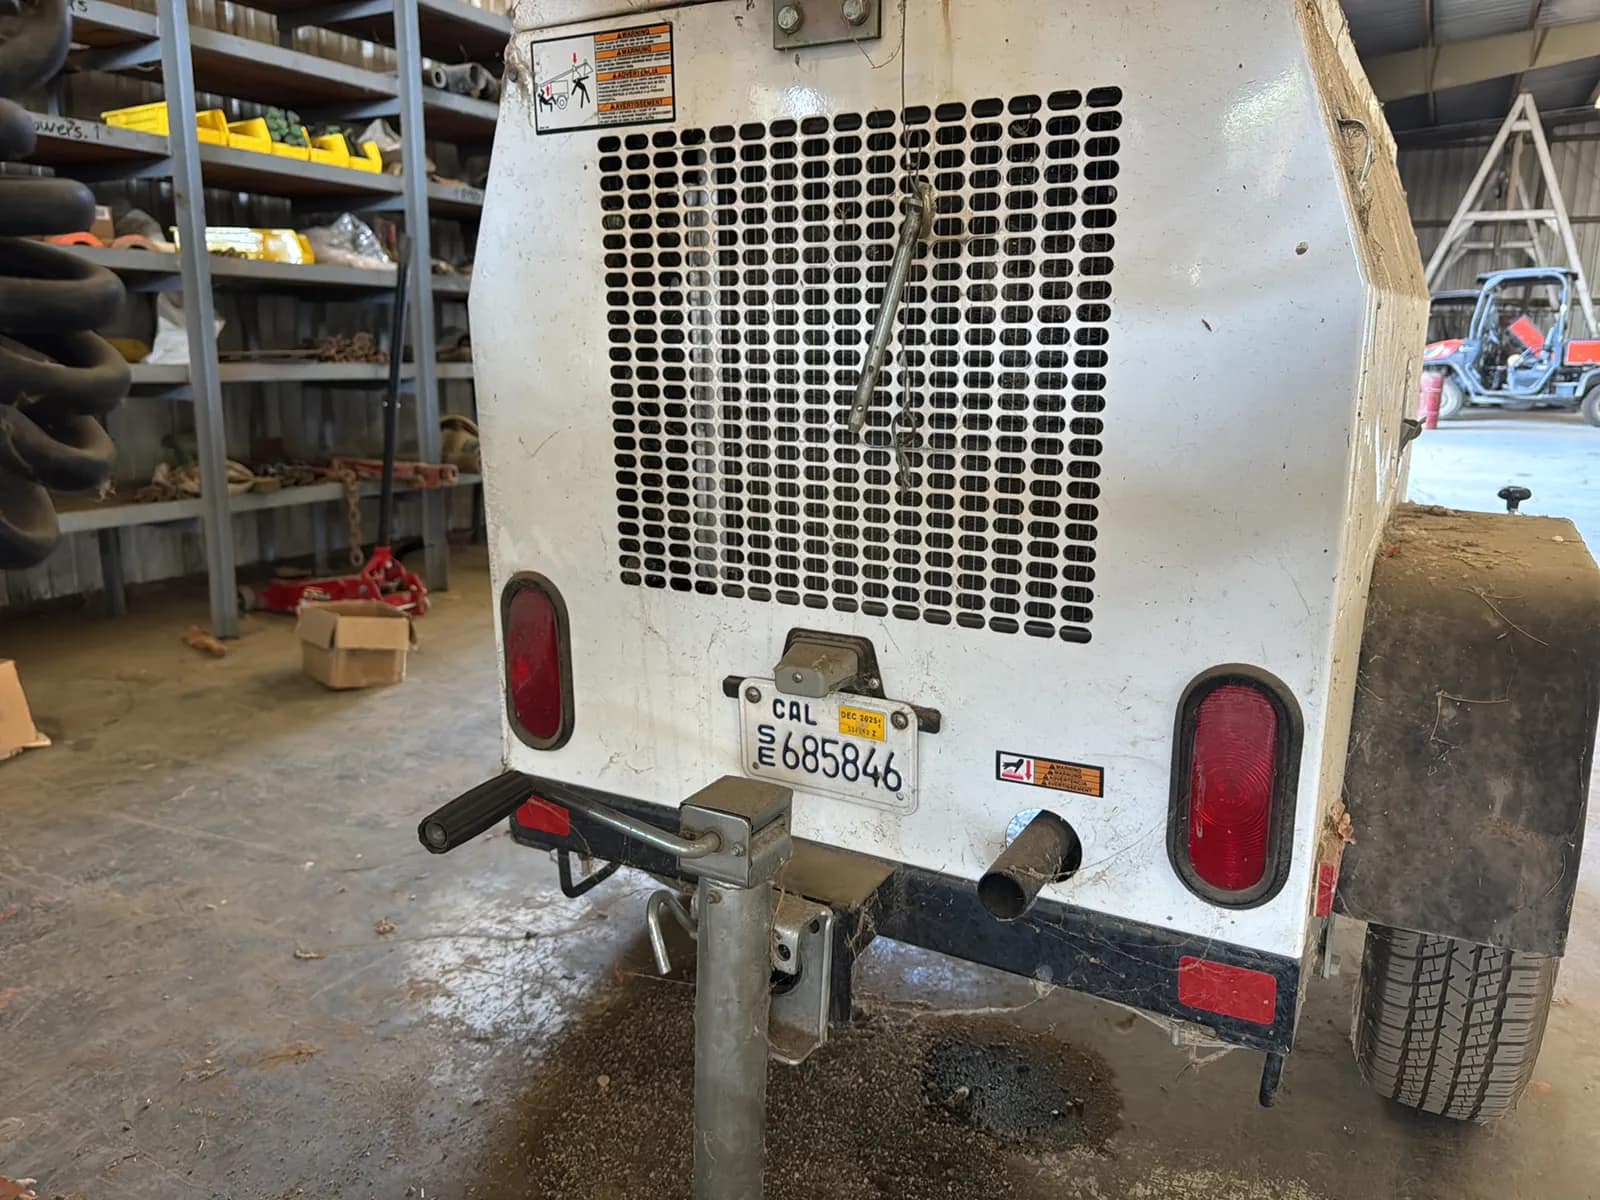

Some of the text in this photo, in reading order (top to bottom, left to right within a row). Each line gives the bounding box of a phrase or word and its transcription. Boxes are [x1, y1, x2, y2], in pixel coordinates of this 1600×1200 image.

[32, 119, 88, 139] owers.
[773, 698, 817, 726] CAL
[840, 711, 857, 720] DEC
[782, 731, 902, 792] 685846
